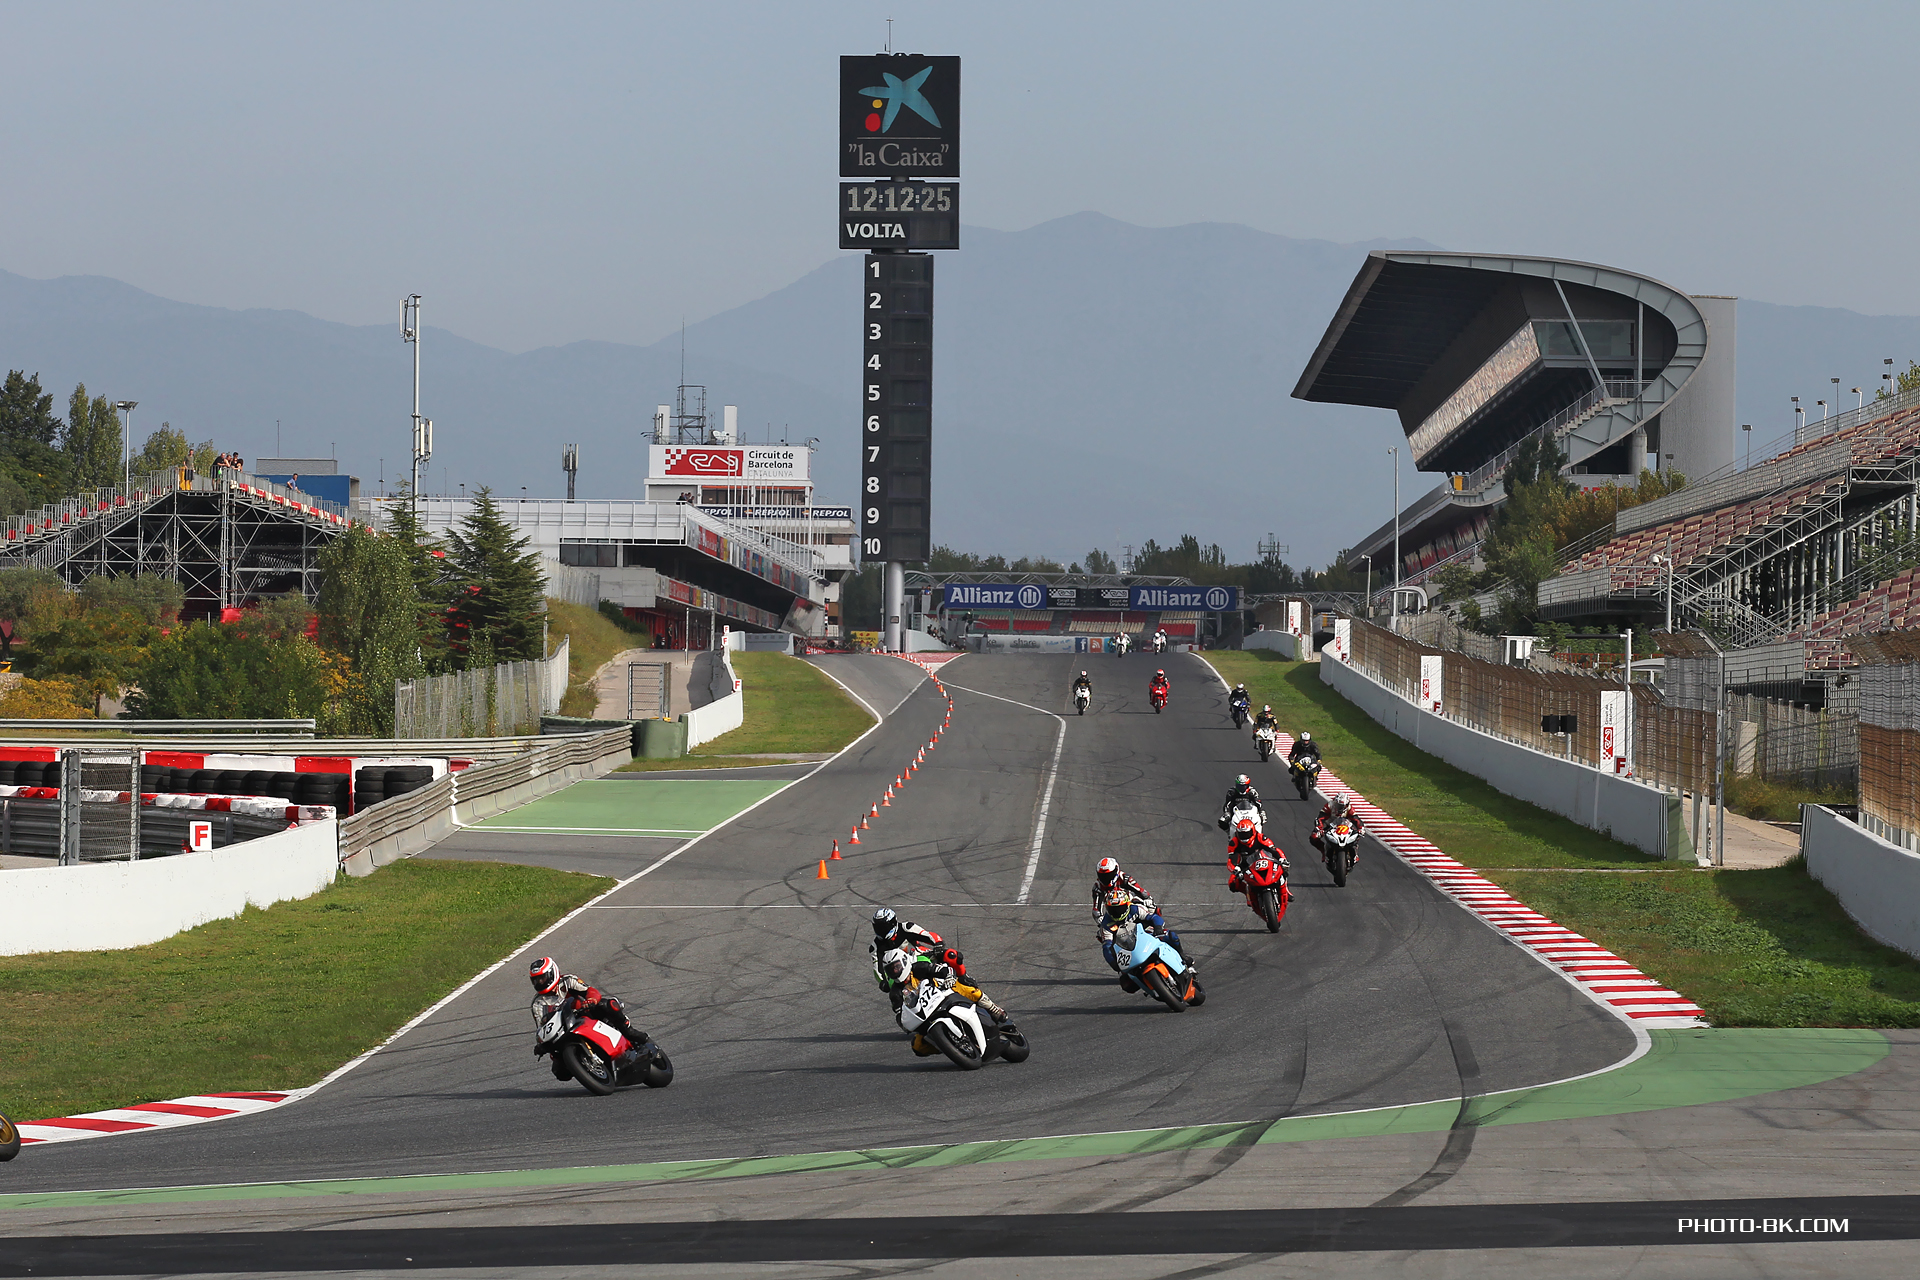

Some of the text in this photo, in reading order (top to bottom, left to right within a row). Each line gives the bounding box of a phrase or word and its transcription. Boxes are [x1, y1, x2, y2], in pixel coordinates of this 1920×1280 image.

[847, 186, 951, 212] 12:12:25
[846, 223, 906, 238] VOLTA
[869, 262, 880, 277] 1
[869, 292, 882, 309] 2
[869, 323, 882, 340] 3
[867, 354, 882, 370] 4
[868, 384, 881, 401] 5
[867, 415, 880, 432] 6
[748, 450, 794, 459] Circuit de
[867, 446, 880, 462] 7
[748, 460, 793, 469] Barcelona
[748, 470, 794, 478] CATALUNYA
[866, 476, 880, 493] 8
[754, 508, 791, 516] REPSOL
[812, 508, 849, 517] REPSOL
[866, 507, 880, 524] 9
[864, 538, 881, 554] 10
[950, 587, 1014, 603] Allianz
[1137, 589, 1202, 606] Allianz
[723, 637, 728, 645] F
[1013, 638, 1037, 647] share
[1341, 653, 1347, 661] F
[1433, 702, 1441, 712] F
[1616, 757, 1626, 773] F
[195, 825, 208, 846] F
[1117, 951, 1131, 966] 232
[919, 985, 938, 1008] 372
